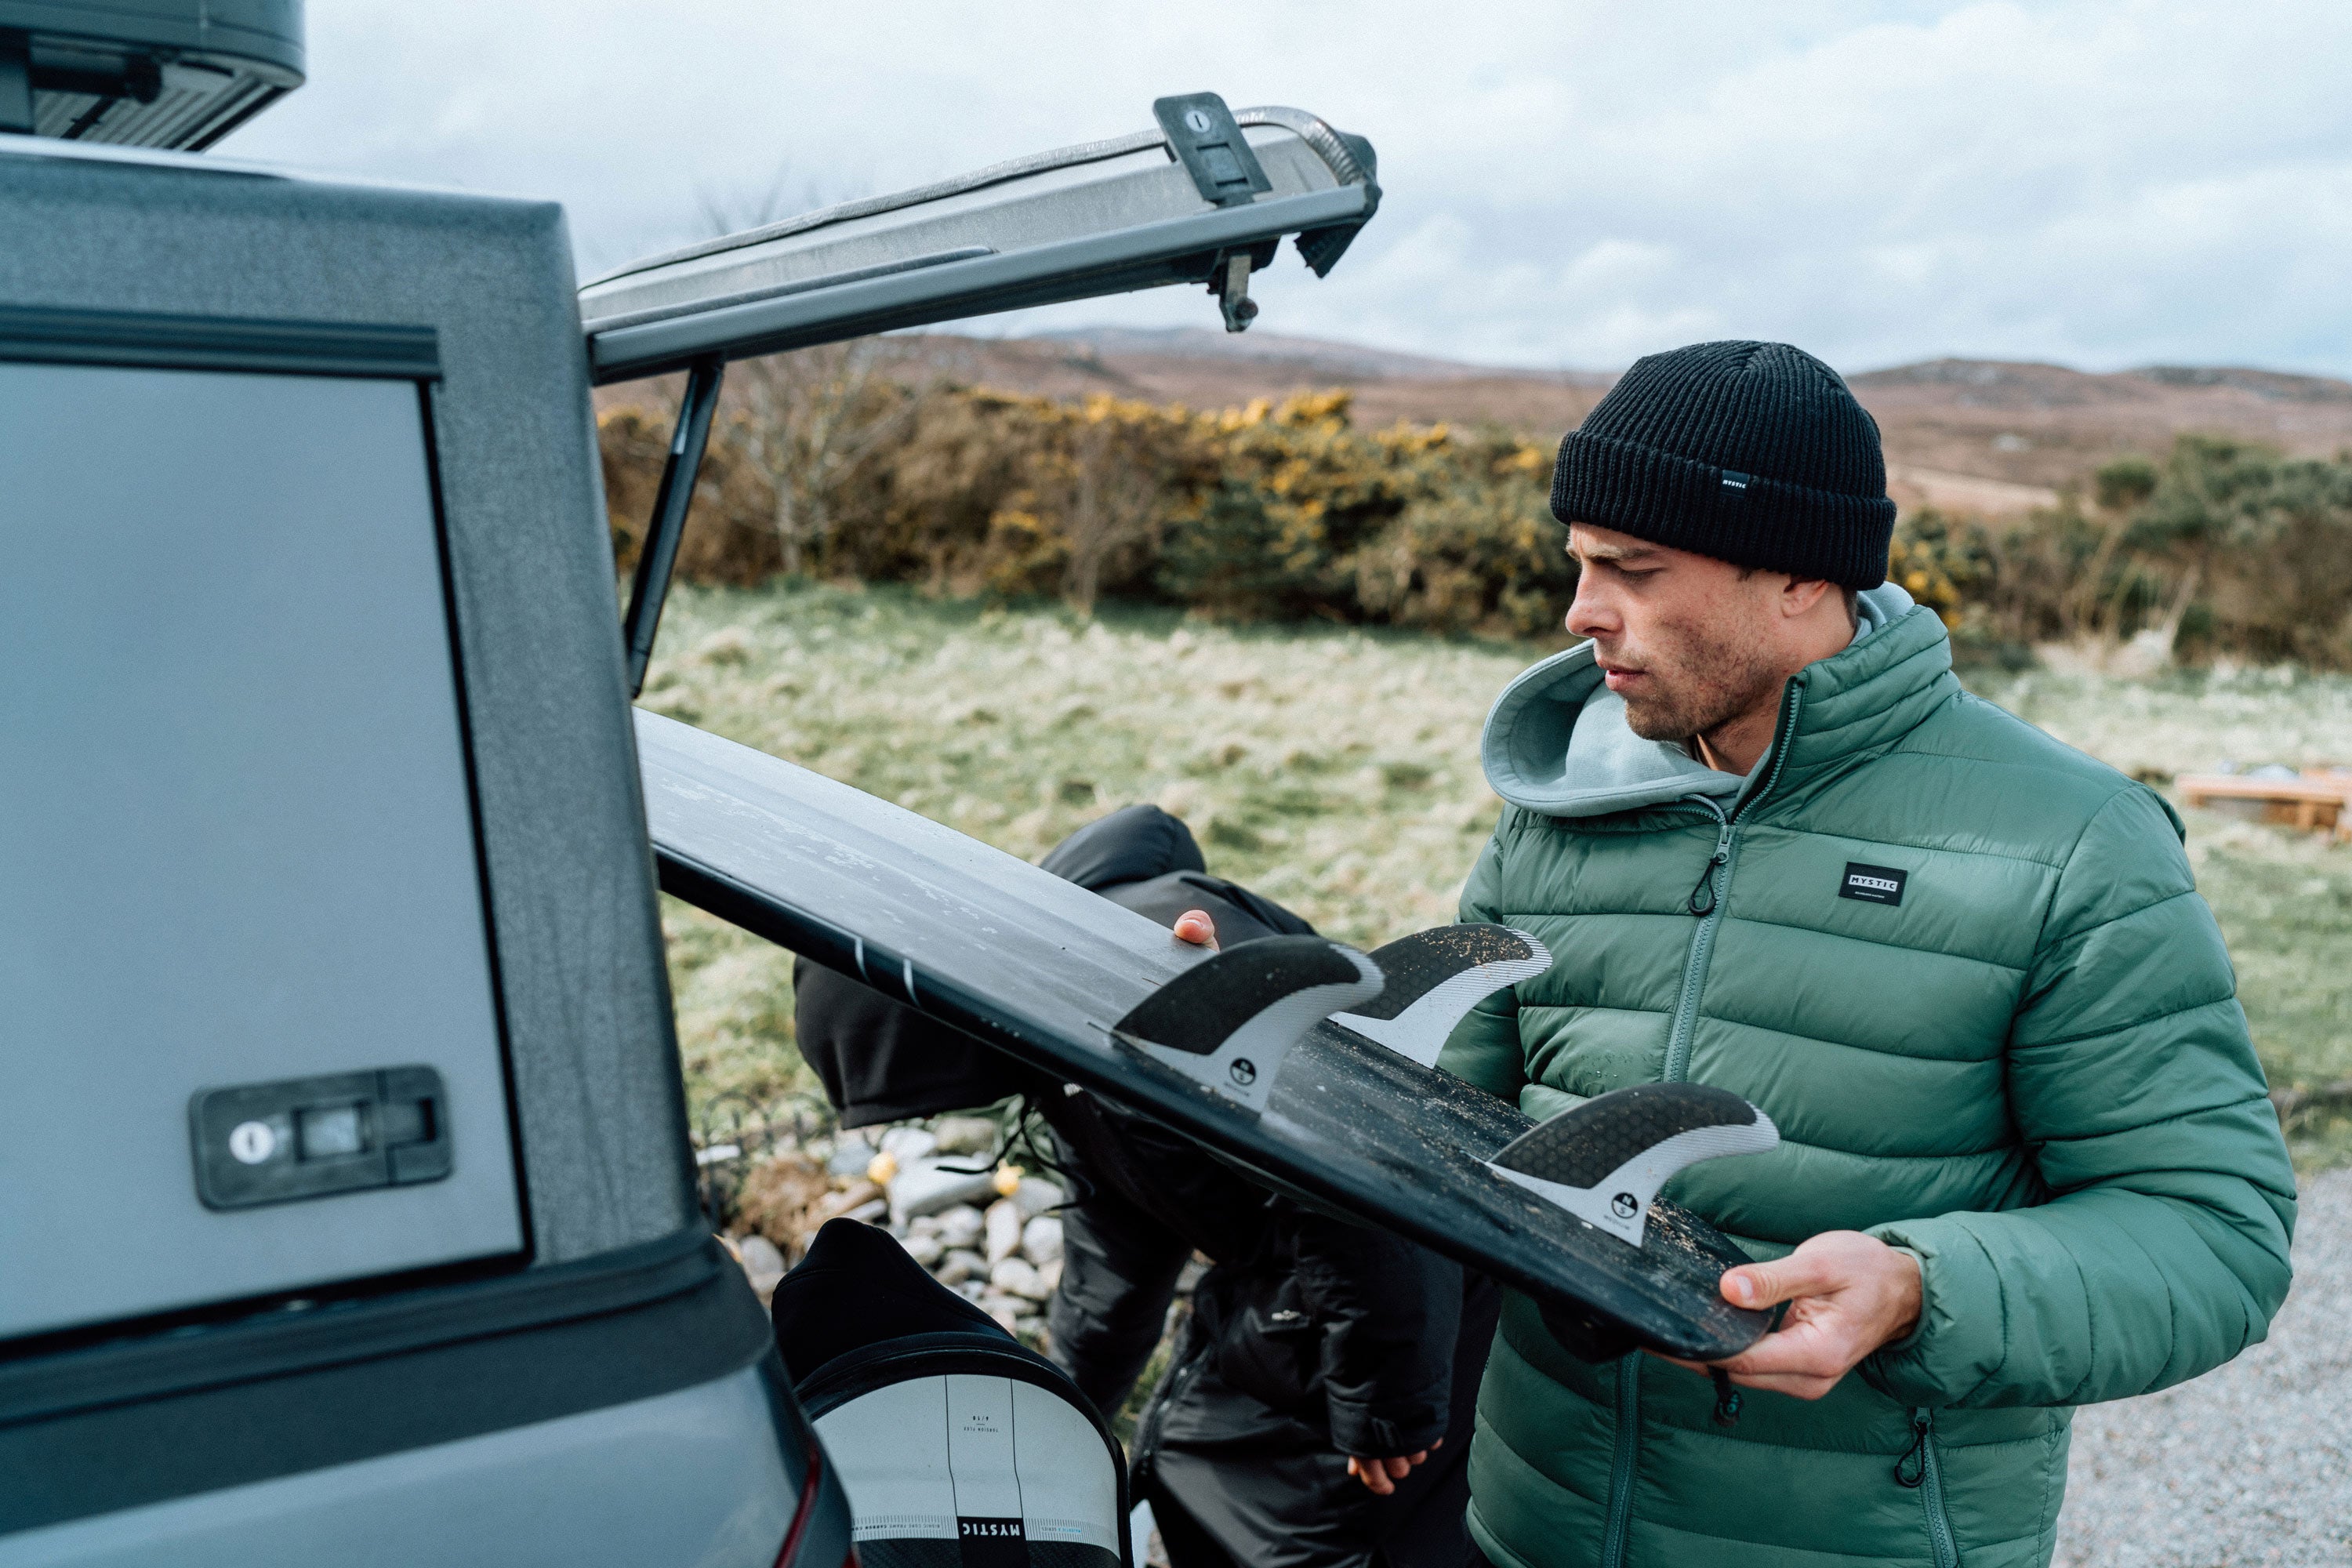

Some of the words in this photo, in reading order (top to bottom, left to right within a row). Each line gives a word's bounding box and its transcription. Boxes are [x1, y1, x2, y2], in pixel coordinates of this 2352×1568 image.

[1722, 479, 1747, 488] MYSTIC
[1851, 877, 1895, 889] MYSTIC
[1621, 1195, 1632, 1206] N
[962, 1523, 1020, 1536] MYSTIC
